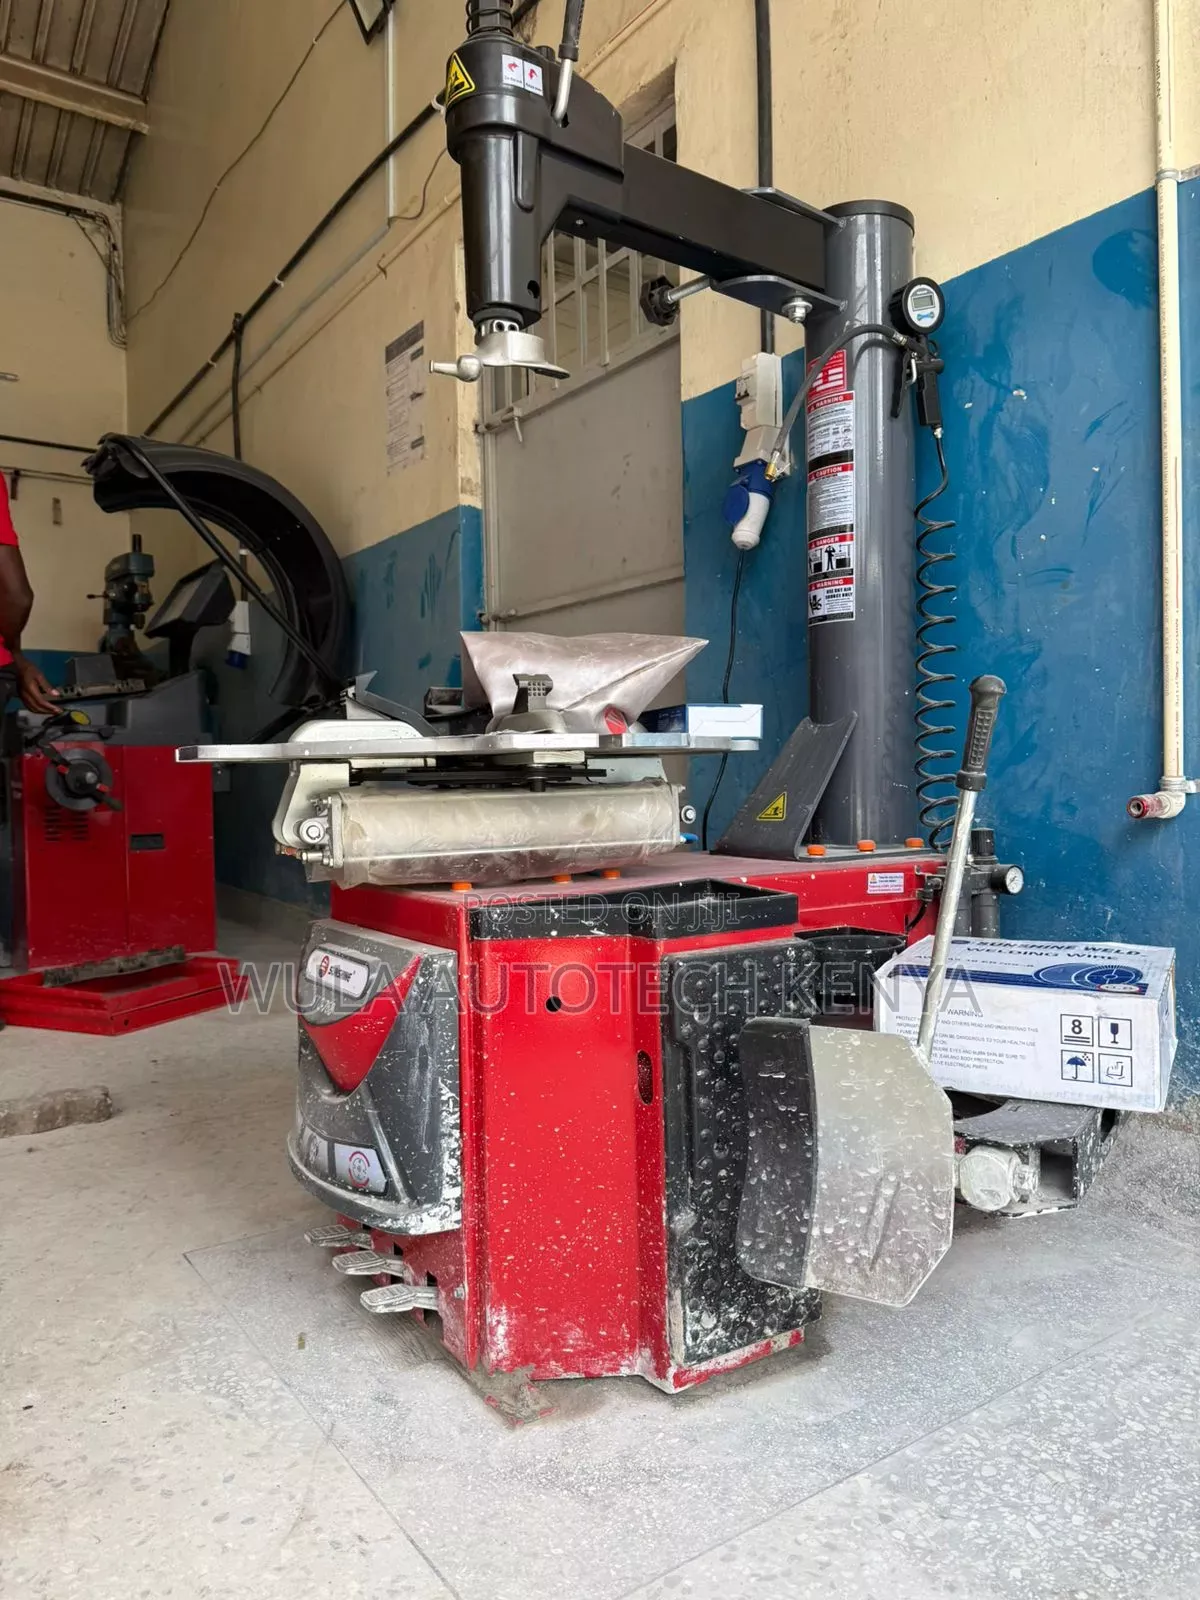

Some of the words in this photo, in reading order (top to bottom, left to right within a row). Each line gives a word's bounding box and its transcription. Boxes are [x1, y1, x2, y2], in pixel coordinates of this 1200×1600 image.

[816, 395, 844, 407] WARNING
[816, 466, 842, 477] CAUTION
[816, 536, 840, 546] DANGER
[817, 579, 844, 588] WARNING
[976, 941, 1078, 950] SUNSHINE
[967, 947, 1059, 957] WELDING
[947, 1009, 984, 1018] WARNING
[1071, 1019, 1083, 1035] 8
